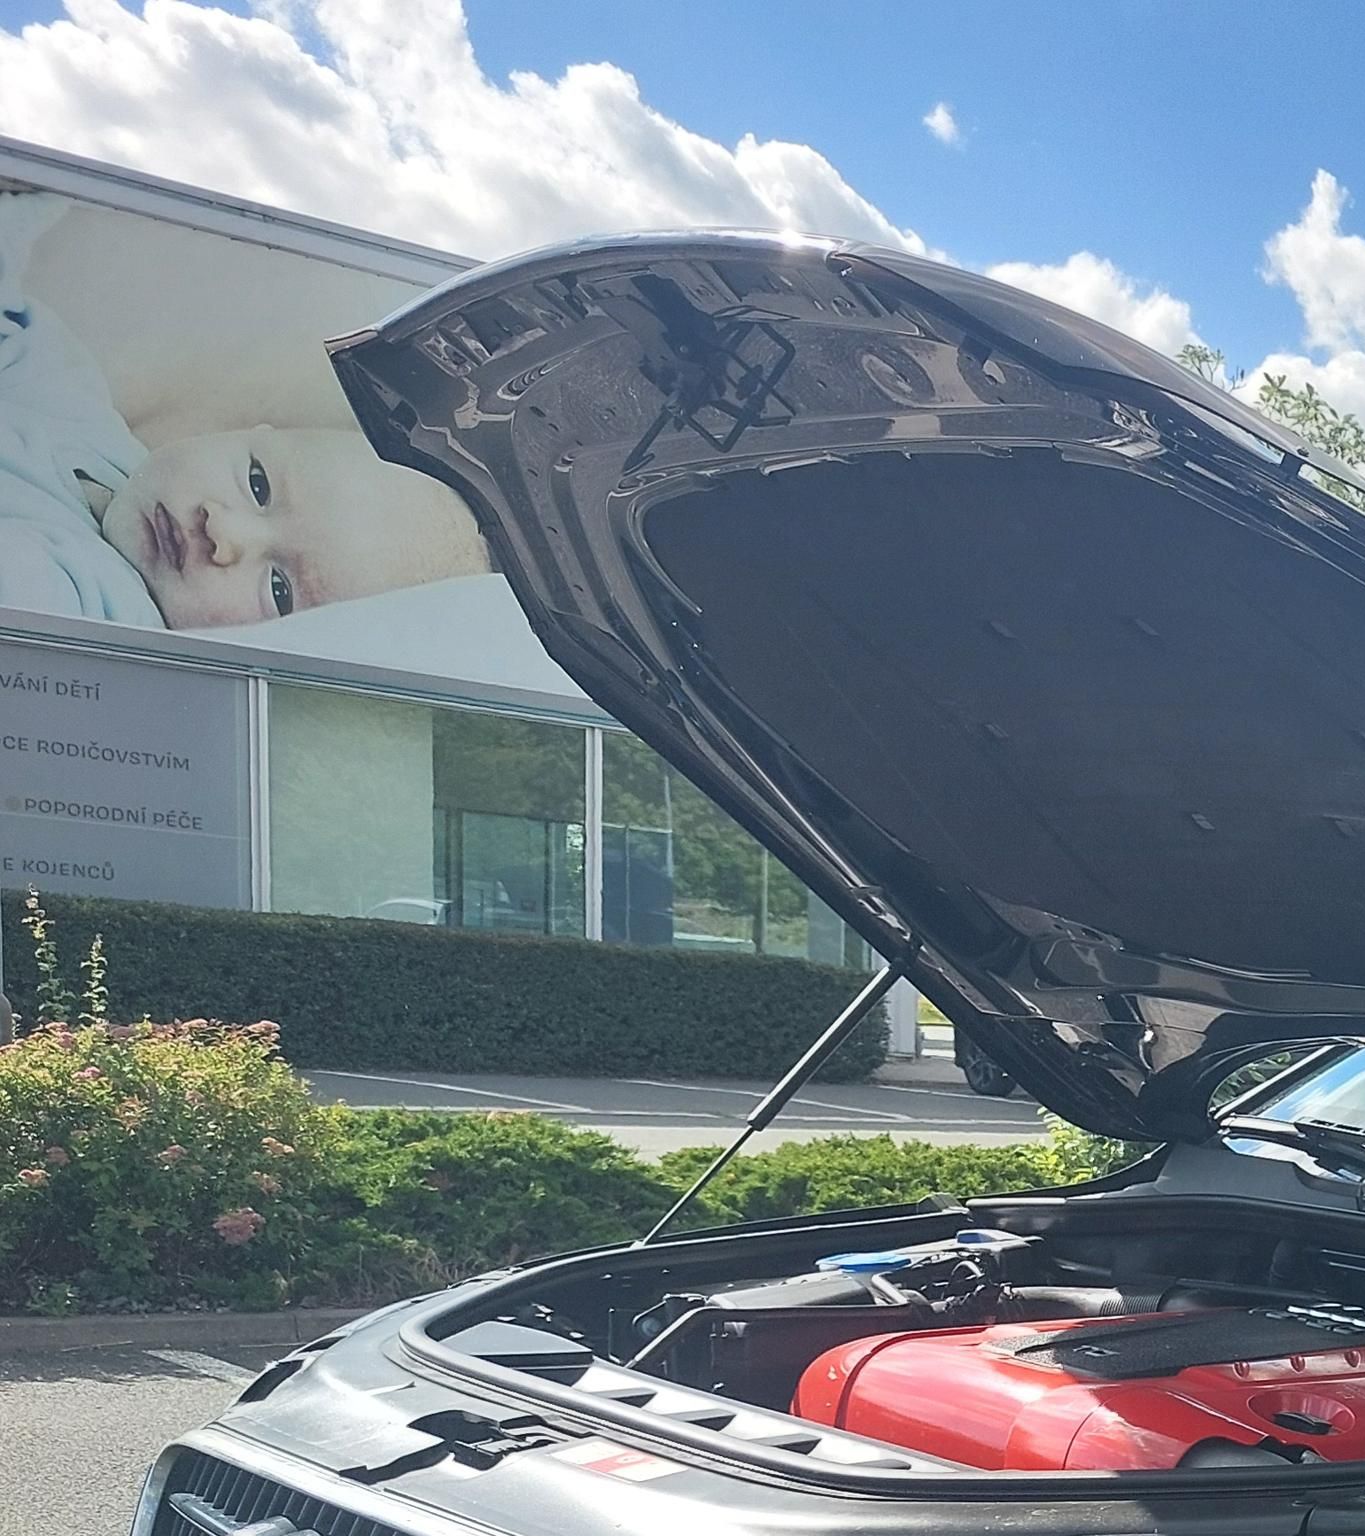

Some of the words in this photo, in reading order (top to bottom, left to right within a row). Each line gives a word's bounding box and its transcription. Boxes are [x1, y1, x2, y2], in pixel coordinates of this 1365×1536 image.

[55, 680, 101, 701] DĚTÍ
[0, 735, 29, 751] CE
[37, 740, 190, 771] RODIČOVSTVÍM
[24, 798, 147, 824] POPORODNÍ
[152, 810, 204, 830] PÉČE
[22, 860, 115, 880] KOJENCŮ
